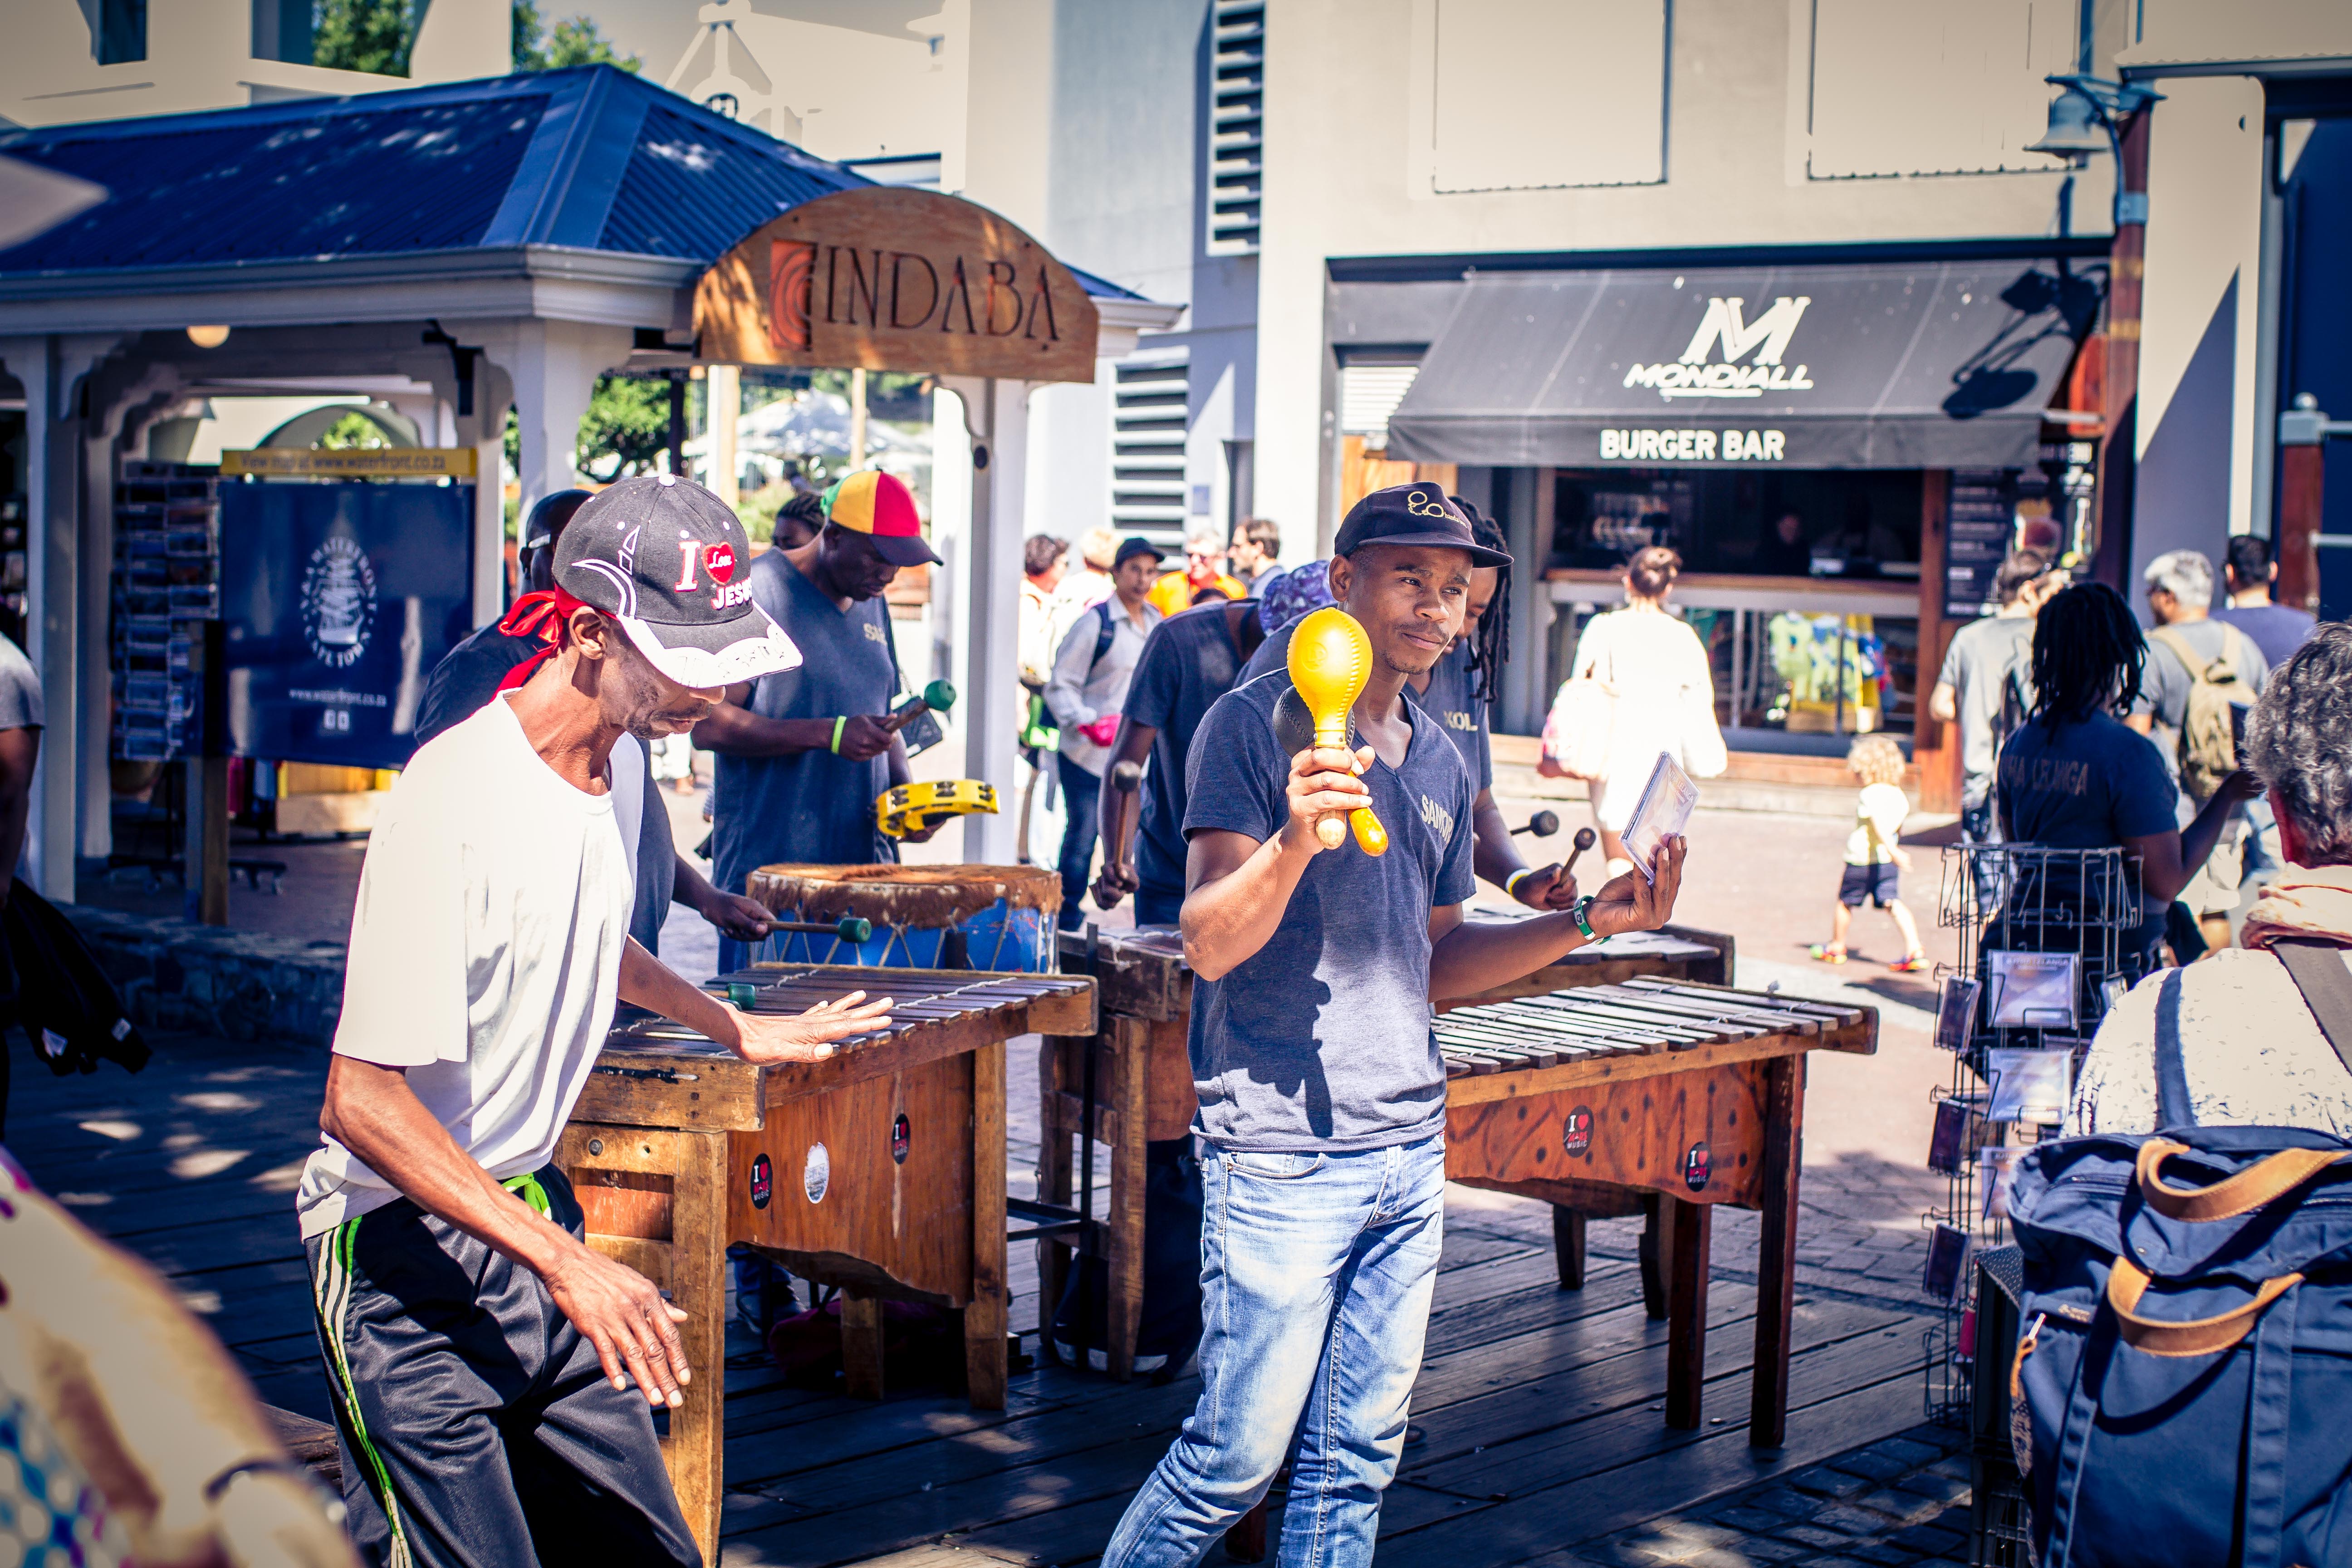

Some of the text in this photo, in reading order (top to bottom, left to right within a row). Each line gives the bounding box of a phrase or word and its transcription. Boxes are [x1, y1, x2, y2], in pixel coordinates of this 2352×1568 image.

[825, 245, 1061, 341] INDABA
[1623, 363, 1814, 391] MONDIALL
[1600, 429, 1786, 461] BURGER BAR
[675, 540, 702, 592] I
[709, 551, 732, 569] Love
